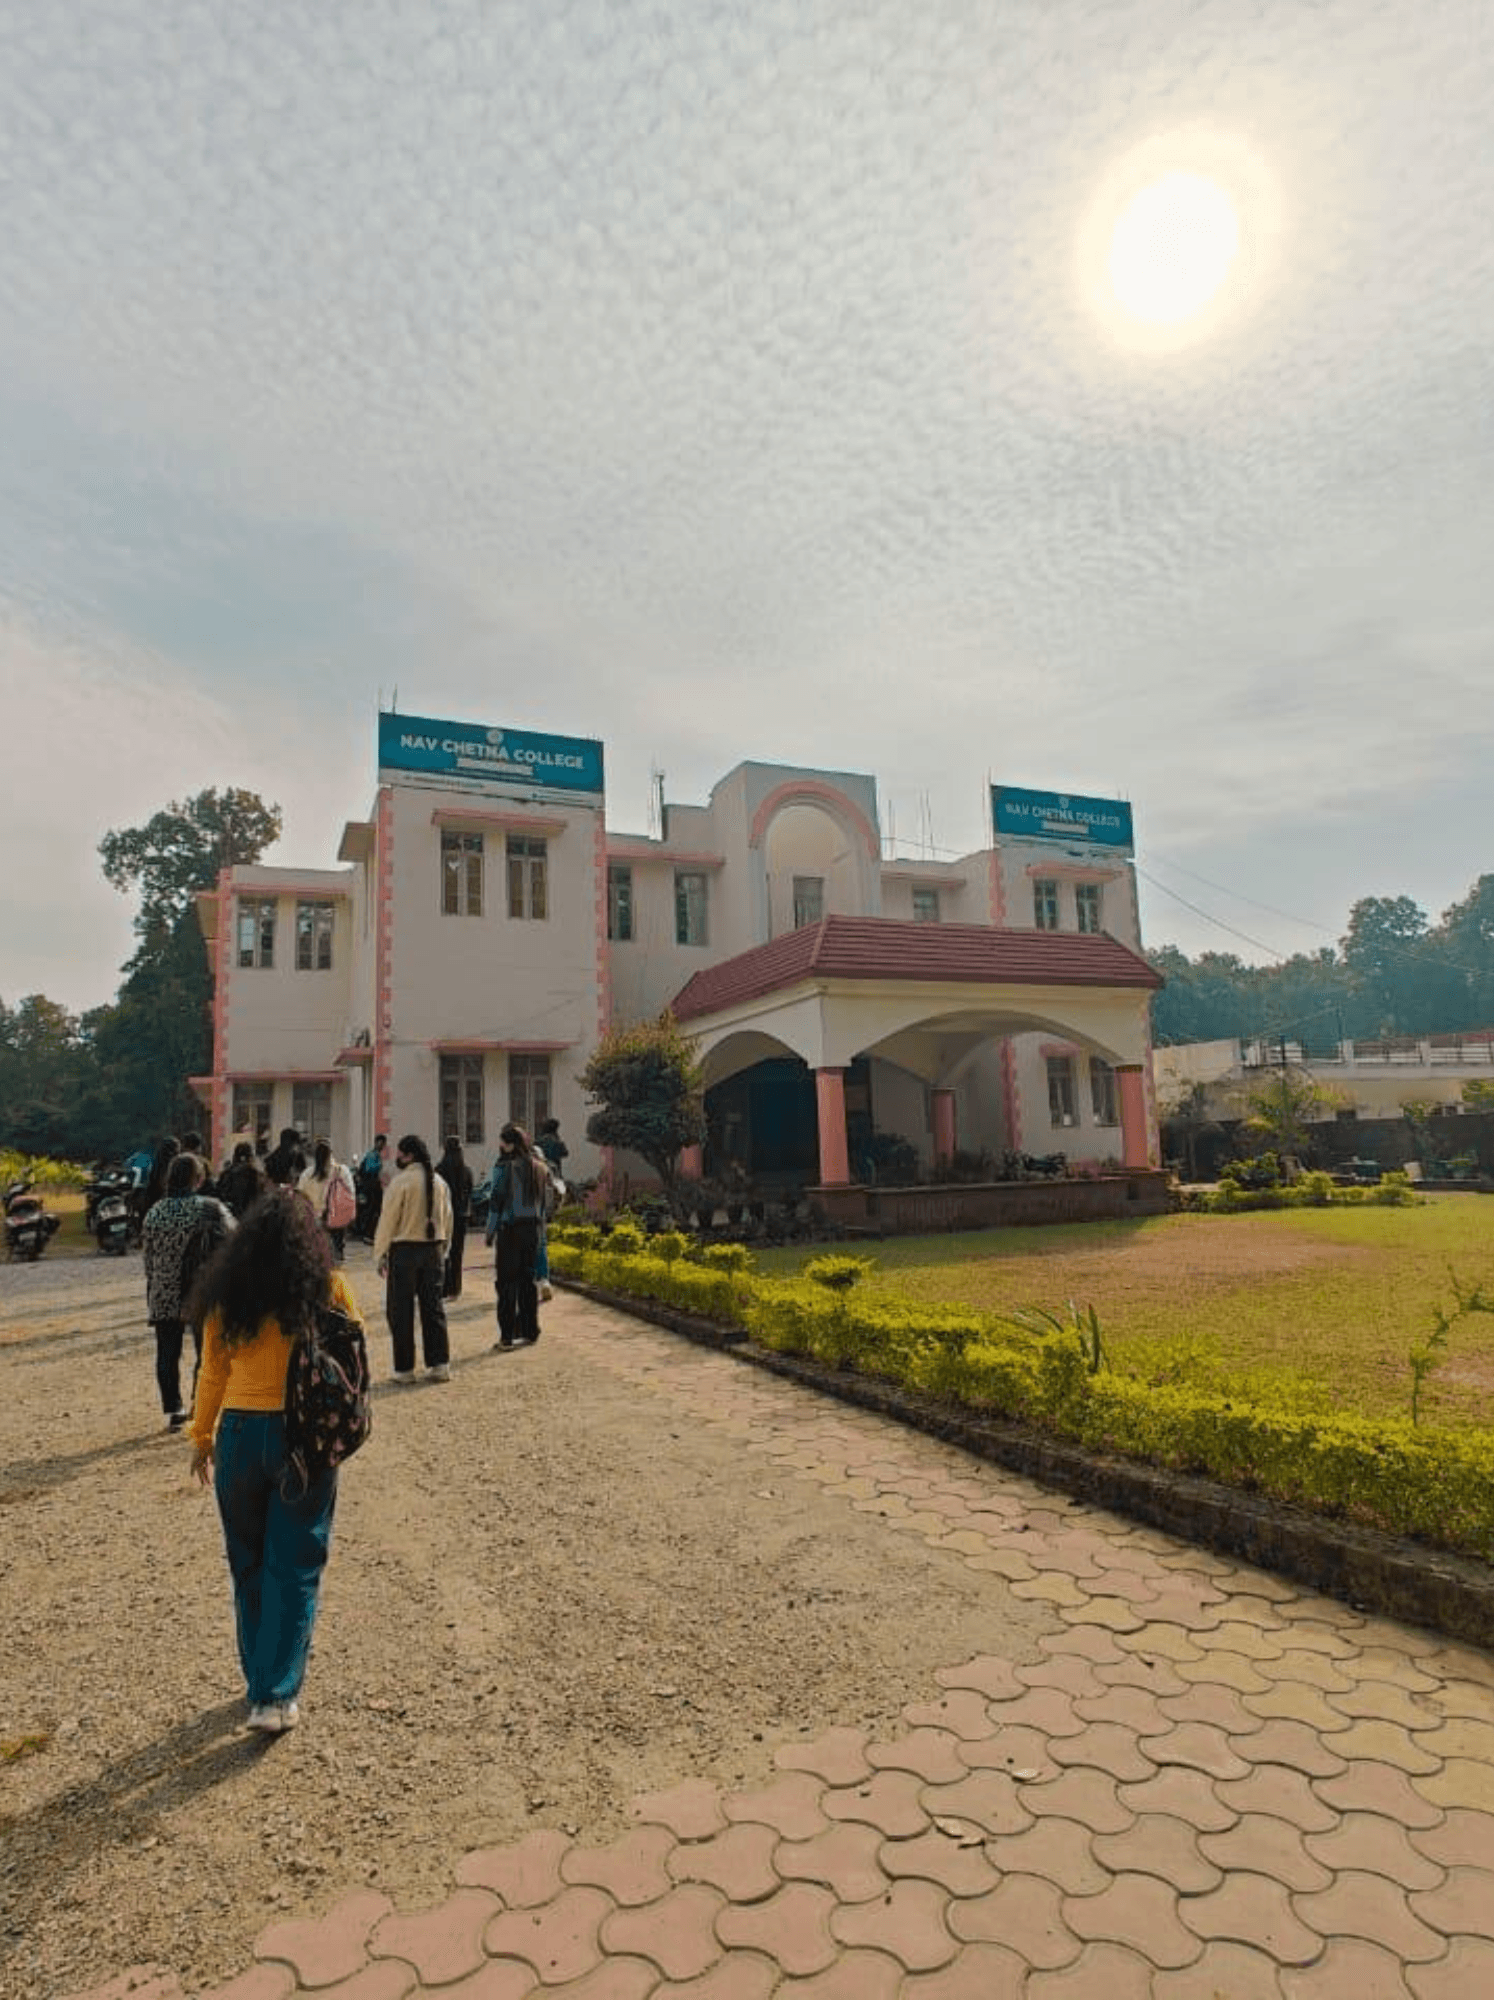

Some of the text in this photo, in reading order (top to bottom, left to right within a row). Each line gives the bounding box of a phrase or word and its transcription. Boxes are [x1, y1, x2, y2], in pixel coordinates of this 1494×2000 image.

[401, 734, 438, 751] NAV
[442, 740, 510, 760] CHETNA
[513, 749, 584, 769] COLLEGE
